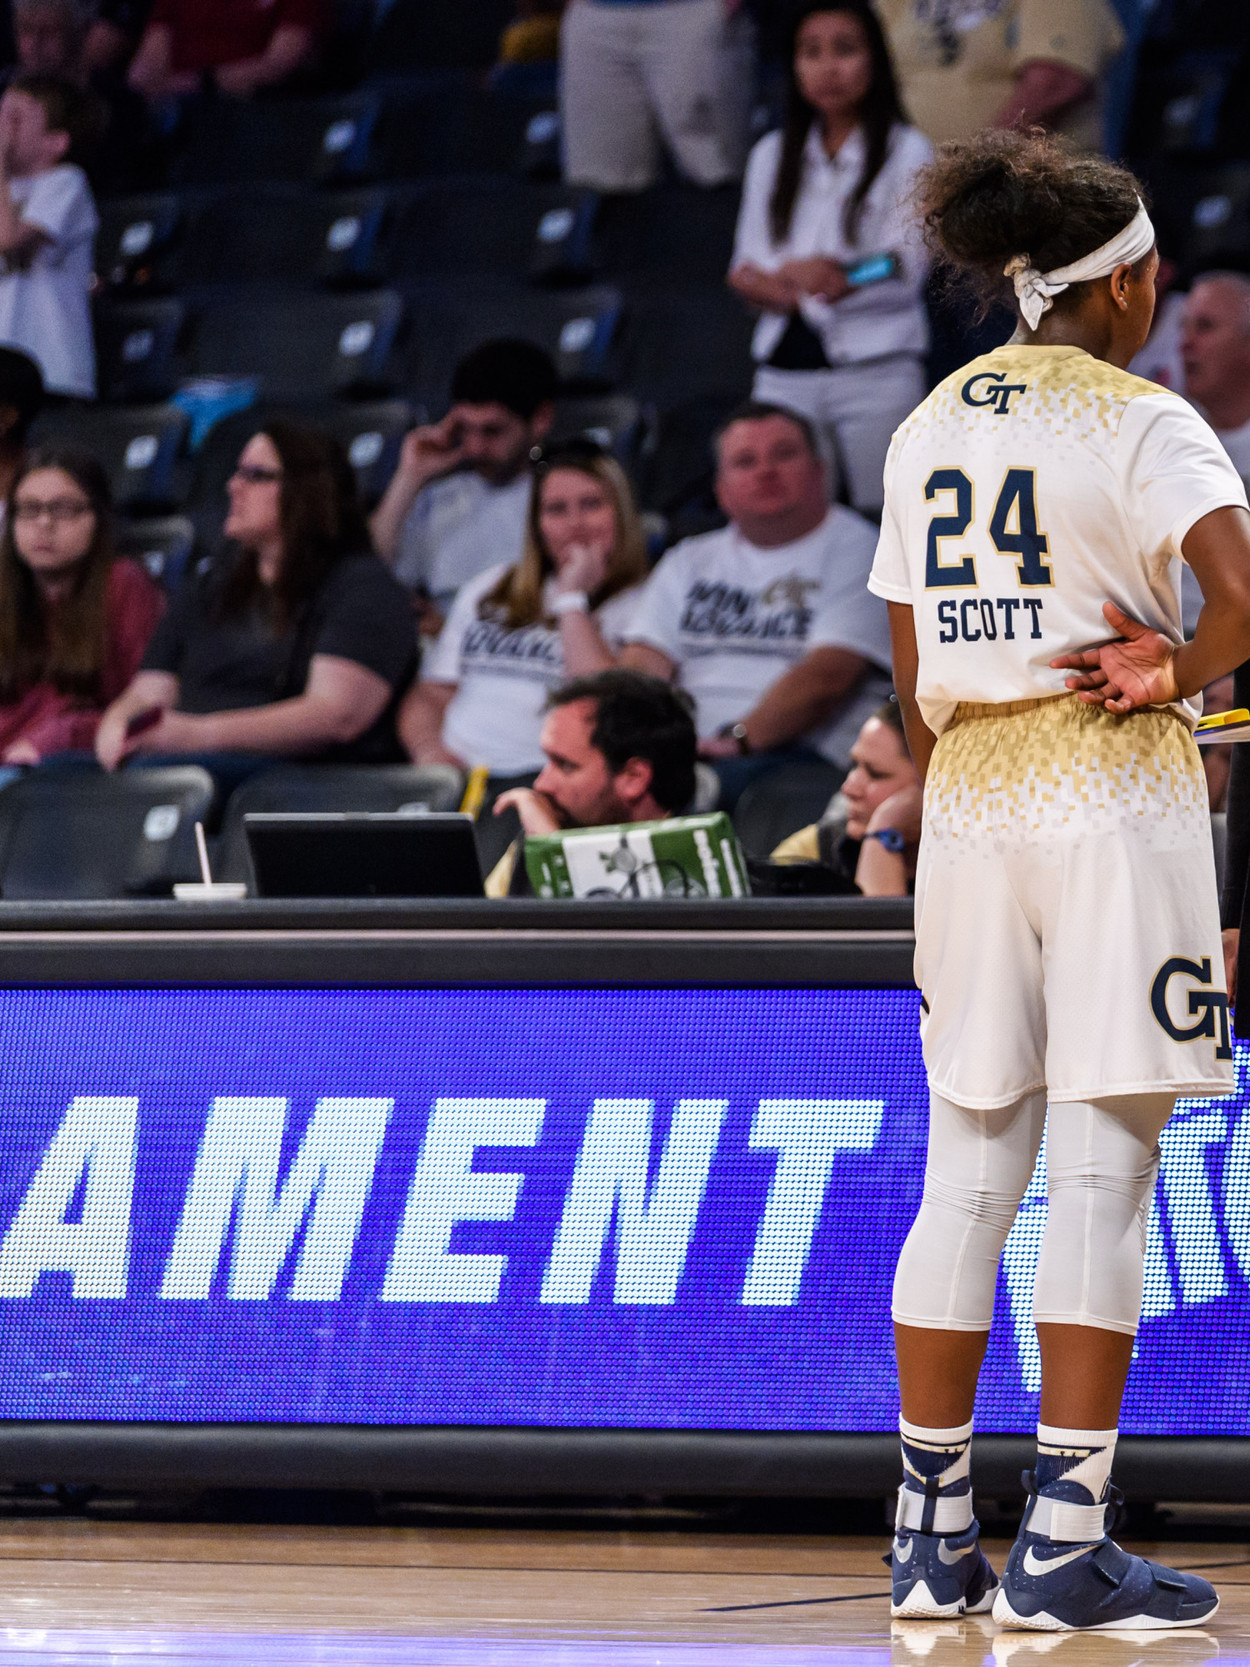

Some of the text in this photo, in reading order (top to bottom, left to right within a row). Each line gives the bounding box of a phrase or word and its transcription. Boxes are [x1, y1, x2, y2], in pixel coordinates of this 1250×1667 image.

[961, 372, 1028, 415] GT
[921, 465, 1056, 592] 24
[937, 598, 1043, 644] SCOTT
[1148, 955, 1234, 1062] GT
[0, 1096, 886, 1306] AMENT
